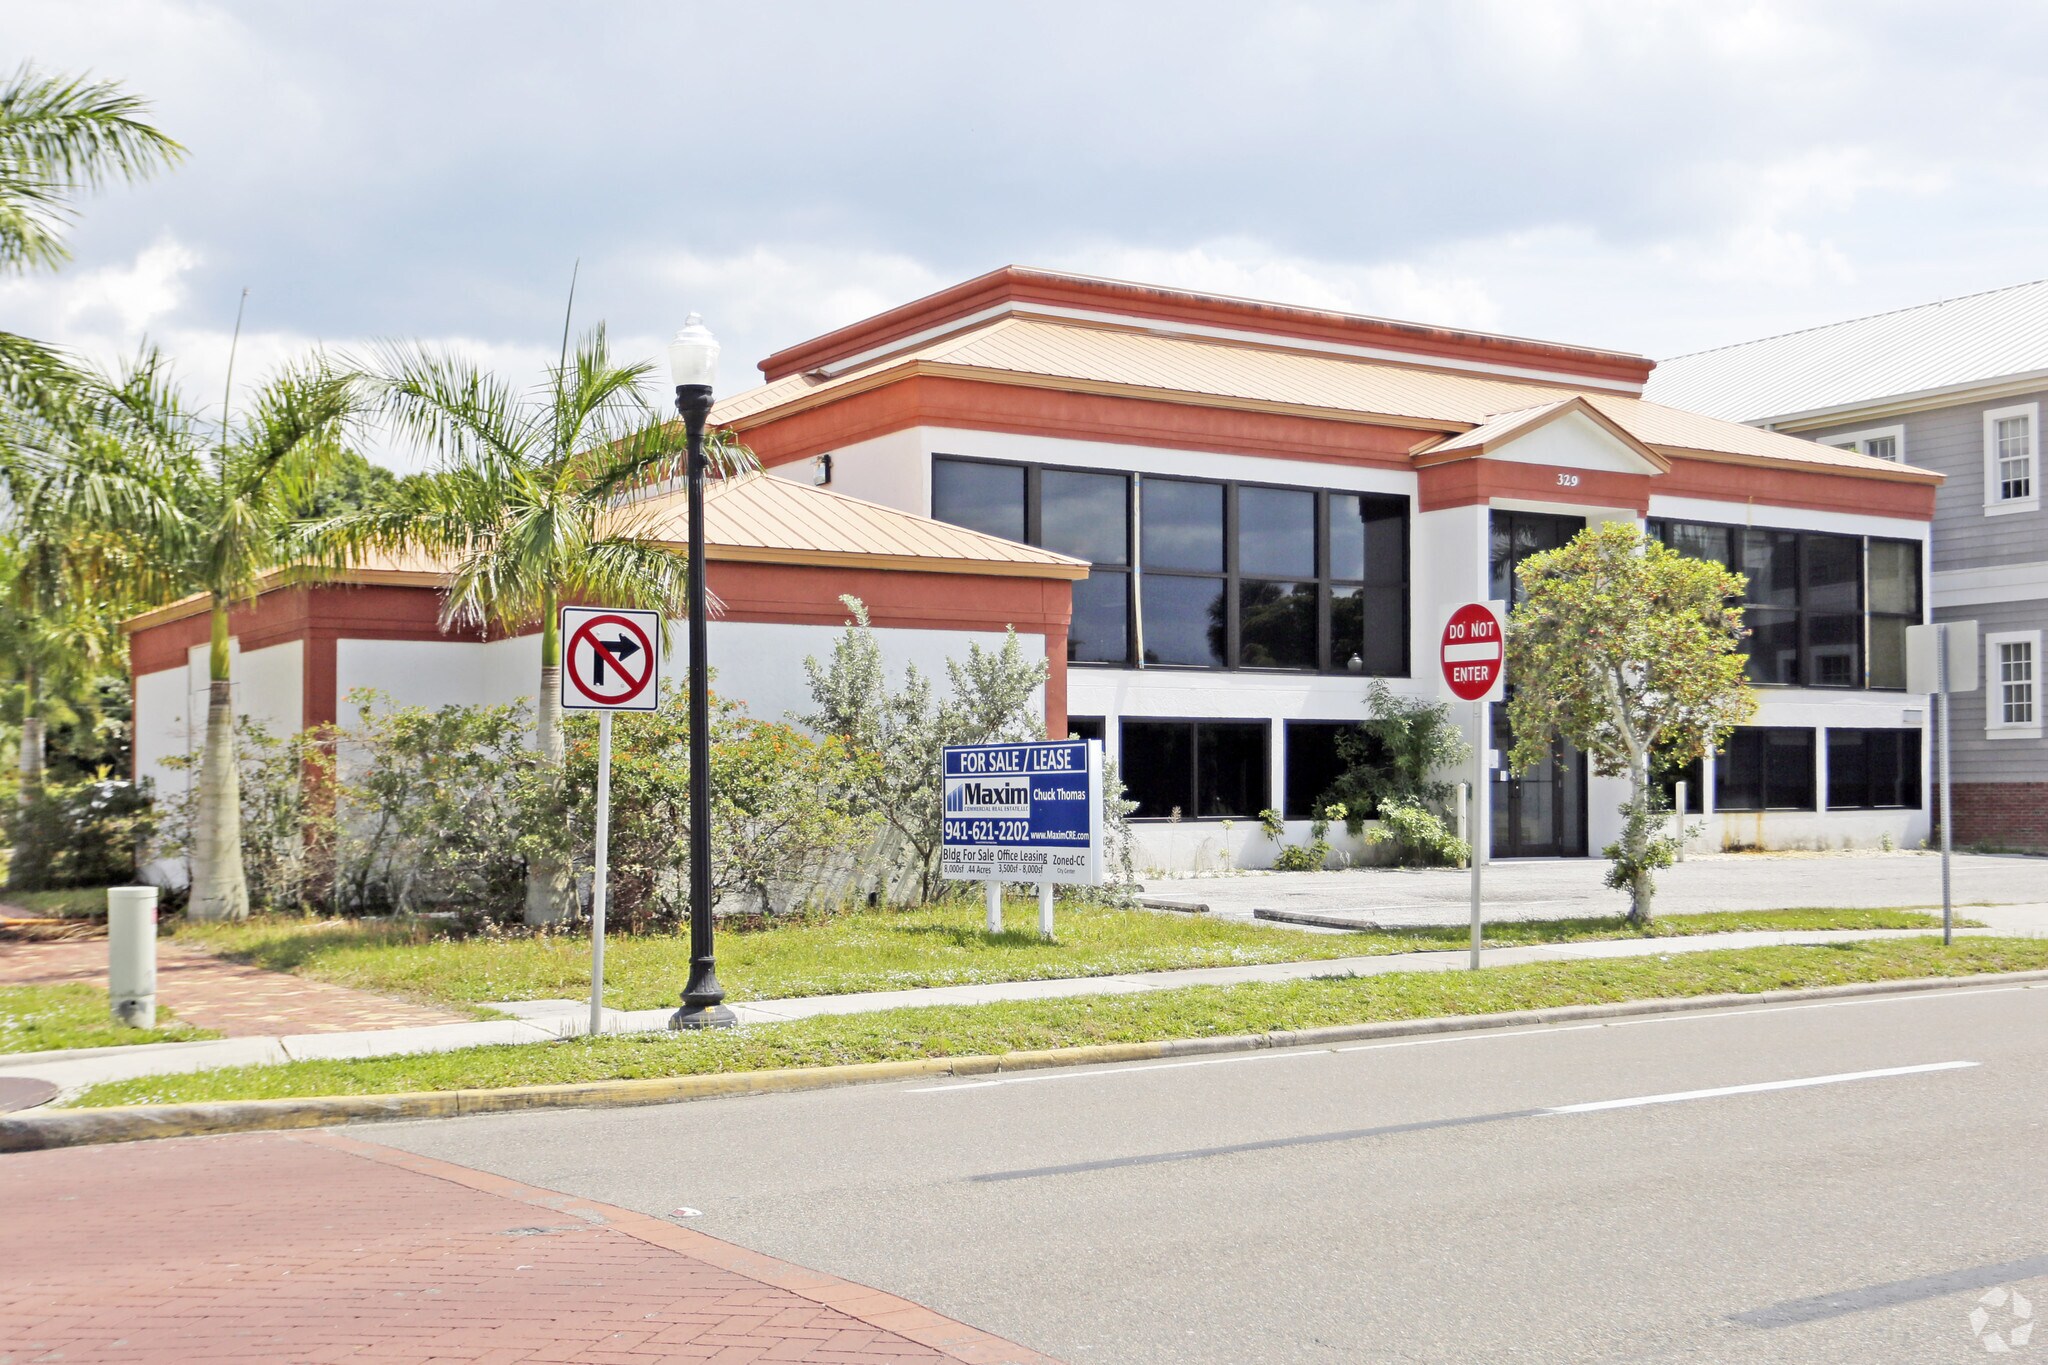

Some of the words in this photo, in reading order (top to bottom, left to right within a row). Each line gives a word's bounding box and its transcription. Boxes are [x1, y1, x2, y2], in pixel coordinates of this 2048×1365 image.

[1556, 473, 1578, 487] 329
[1449, 624, 1465, 639] DO
[1471, 621, 1494, 638] NOT
[1453, 666, 1489, 682] ENTER
[960, 752, 986, 772] FOR
[989, 751, 1020, 772] SALE
[1023, 748, 1030, 773] /
[1033, 748, 1072, 771] LEASE
[964, 782, 1029, 805] Maxim
[1033, 787, 1056, 801] Chuck
[1056, 787, 1086, 801] Thomas
[945, 820, 1030, 841] 941-621-2202
[1030, 829, 1090, 841] www.MaximCRE.com
[943, 848, 961, 863] Bldg
[963, 848, 976, 861] For
[977, 848, 995, 861] Sale
[997, 849, 1018, 861] Office
[1020, 850, 1048, 864] Leasing
[1052, 854, 1085, 866] Zoned-CC
[943, 864, 964, 874] 8,000sf
[976, 865, 992, 875] Acres
[998, 863, 1018, 874] 3,500sf
[1022, 864, 1043, 875] 8,000sf
